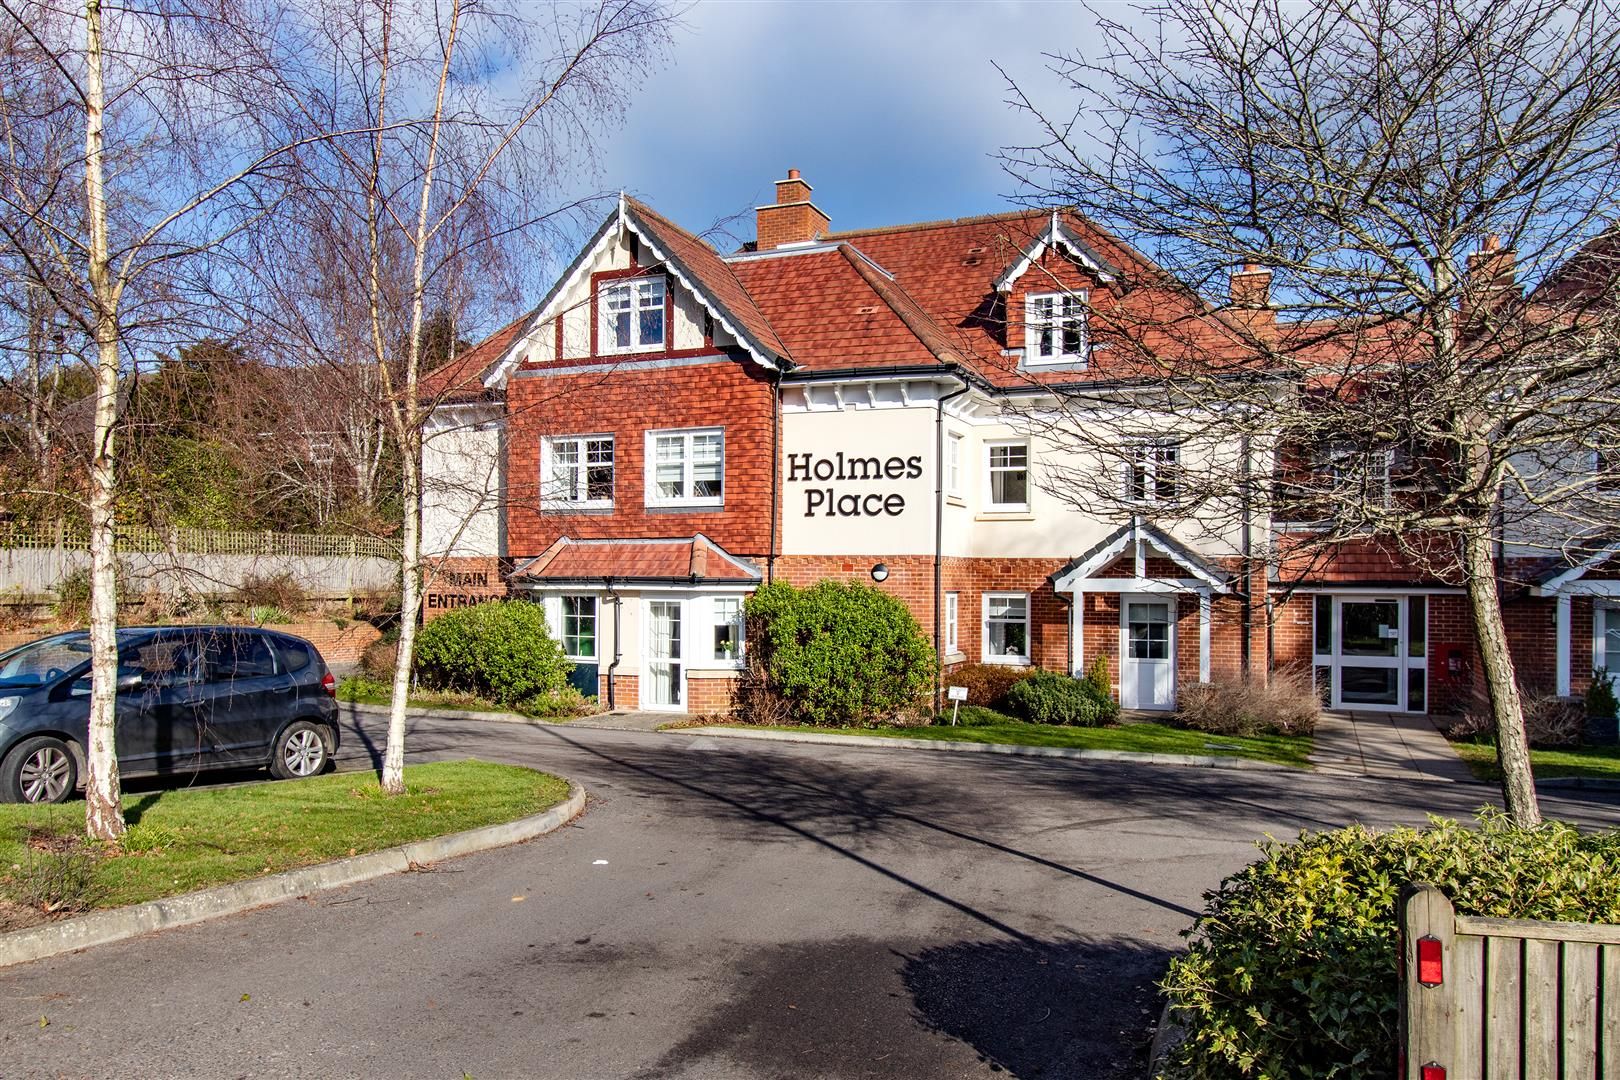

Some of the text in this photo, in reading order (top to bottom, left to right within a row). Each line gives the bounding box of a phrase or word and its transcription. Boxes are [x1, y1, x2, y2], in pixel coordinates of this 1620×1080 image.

[787, 452, 922, 481] Holmes
[804, 488, 905, 517] Place
[449, 572, 488, 587] MAIN
